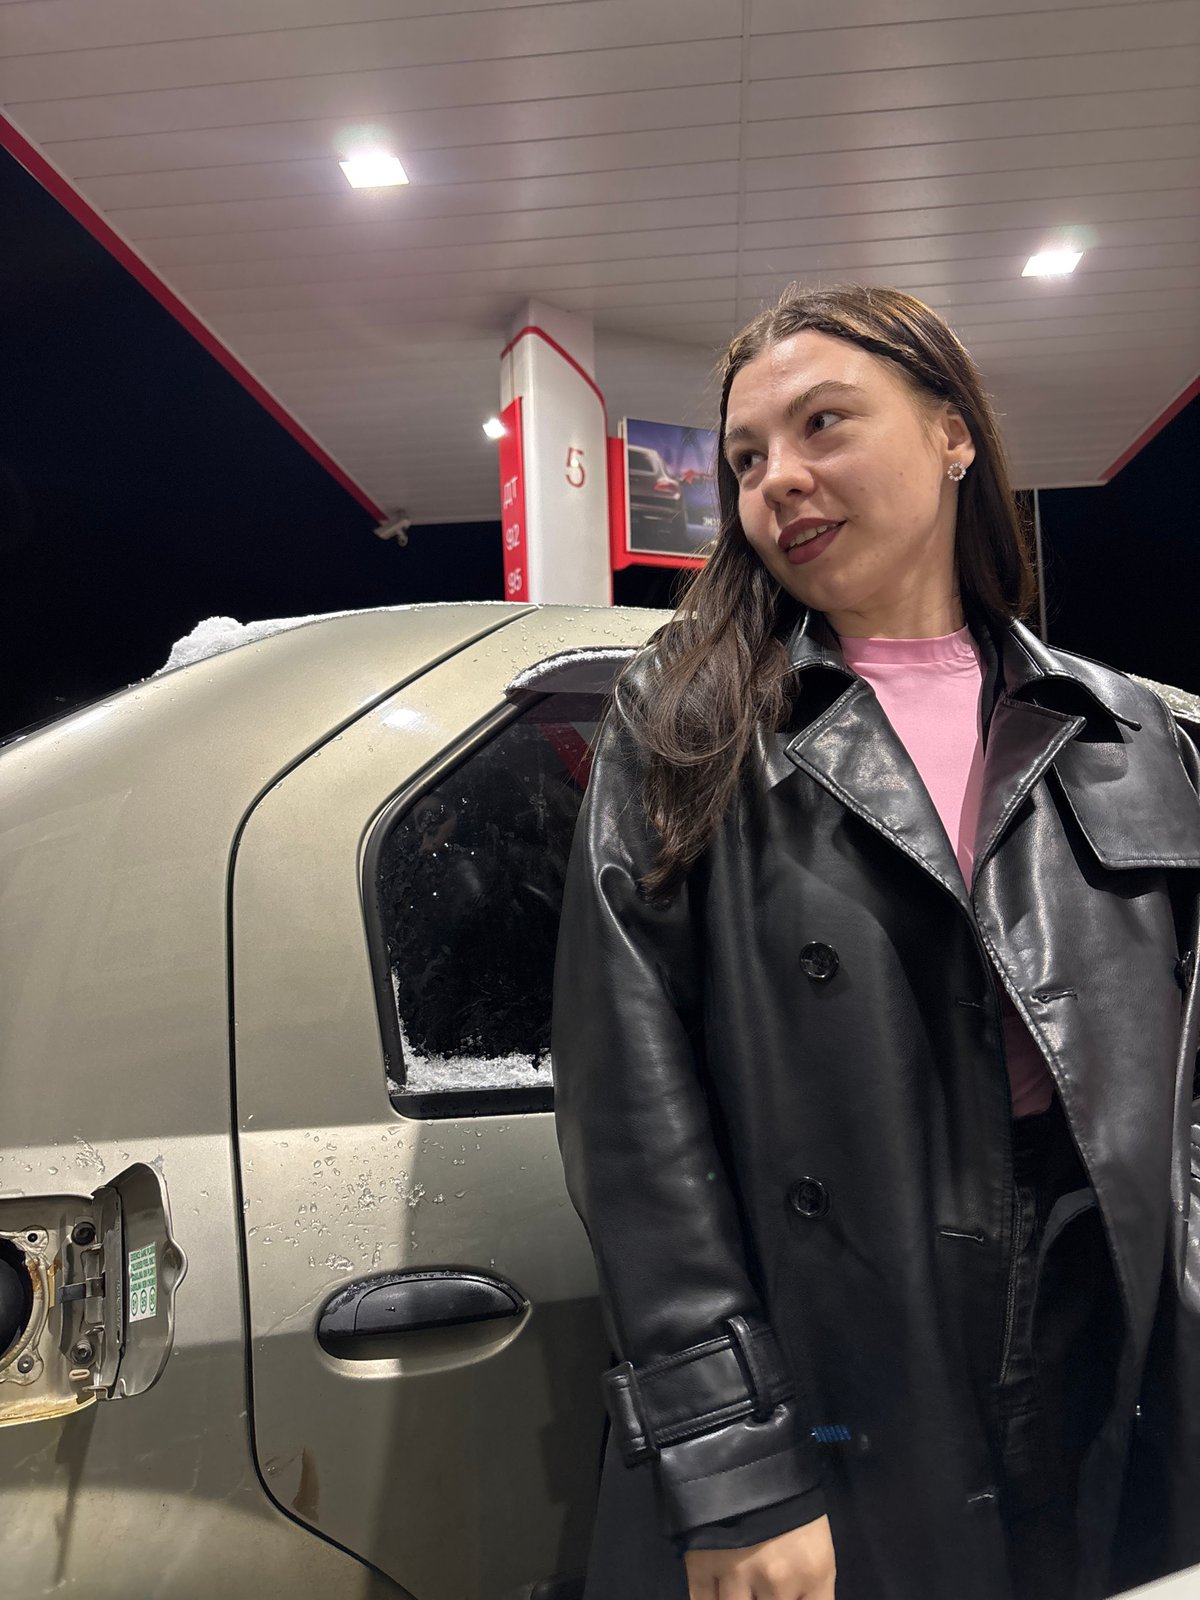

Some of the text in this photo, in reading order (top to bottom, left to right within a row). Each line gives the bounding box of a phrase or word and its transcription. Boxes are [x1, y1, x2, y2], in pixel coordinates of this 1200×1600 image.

[566, 447, 585, 488] 5
[504, 476, 518, 509] ДТ
[506, 523, 520, 550] 92
[508, 567, 522, 594] 95
